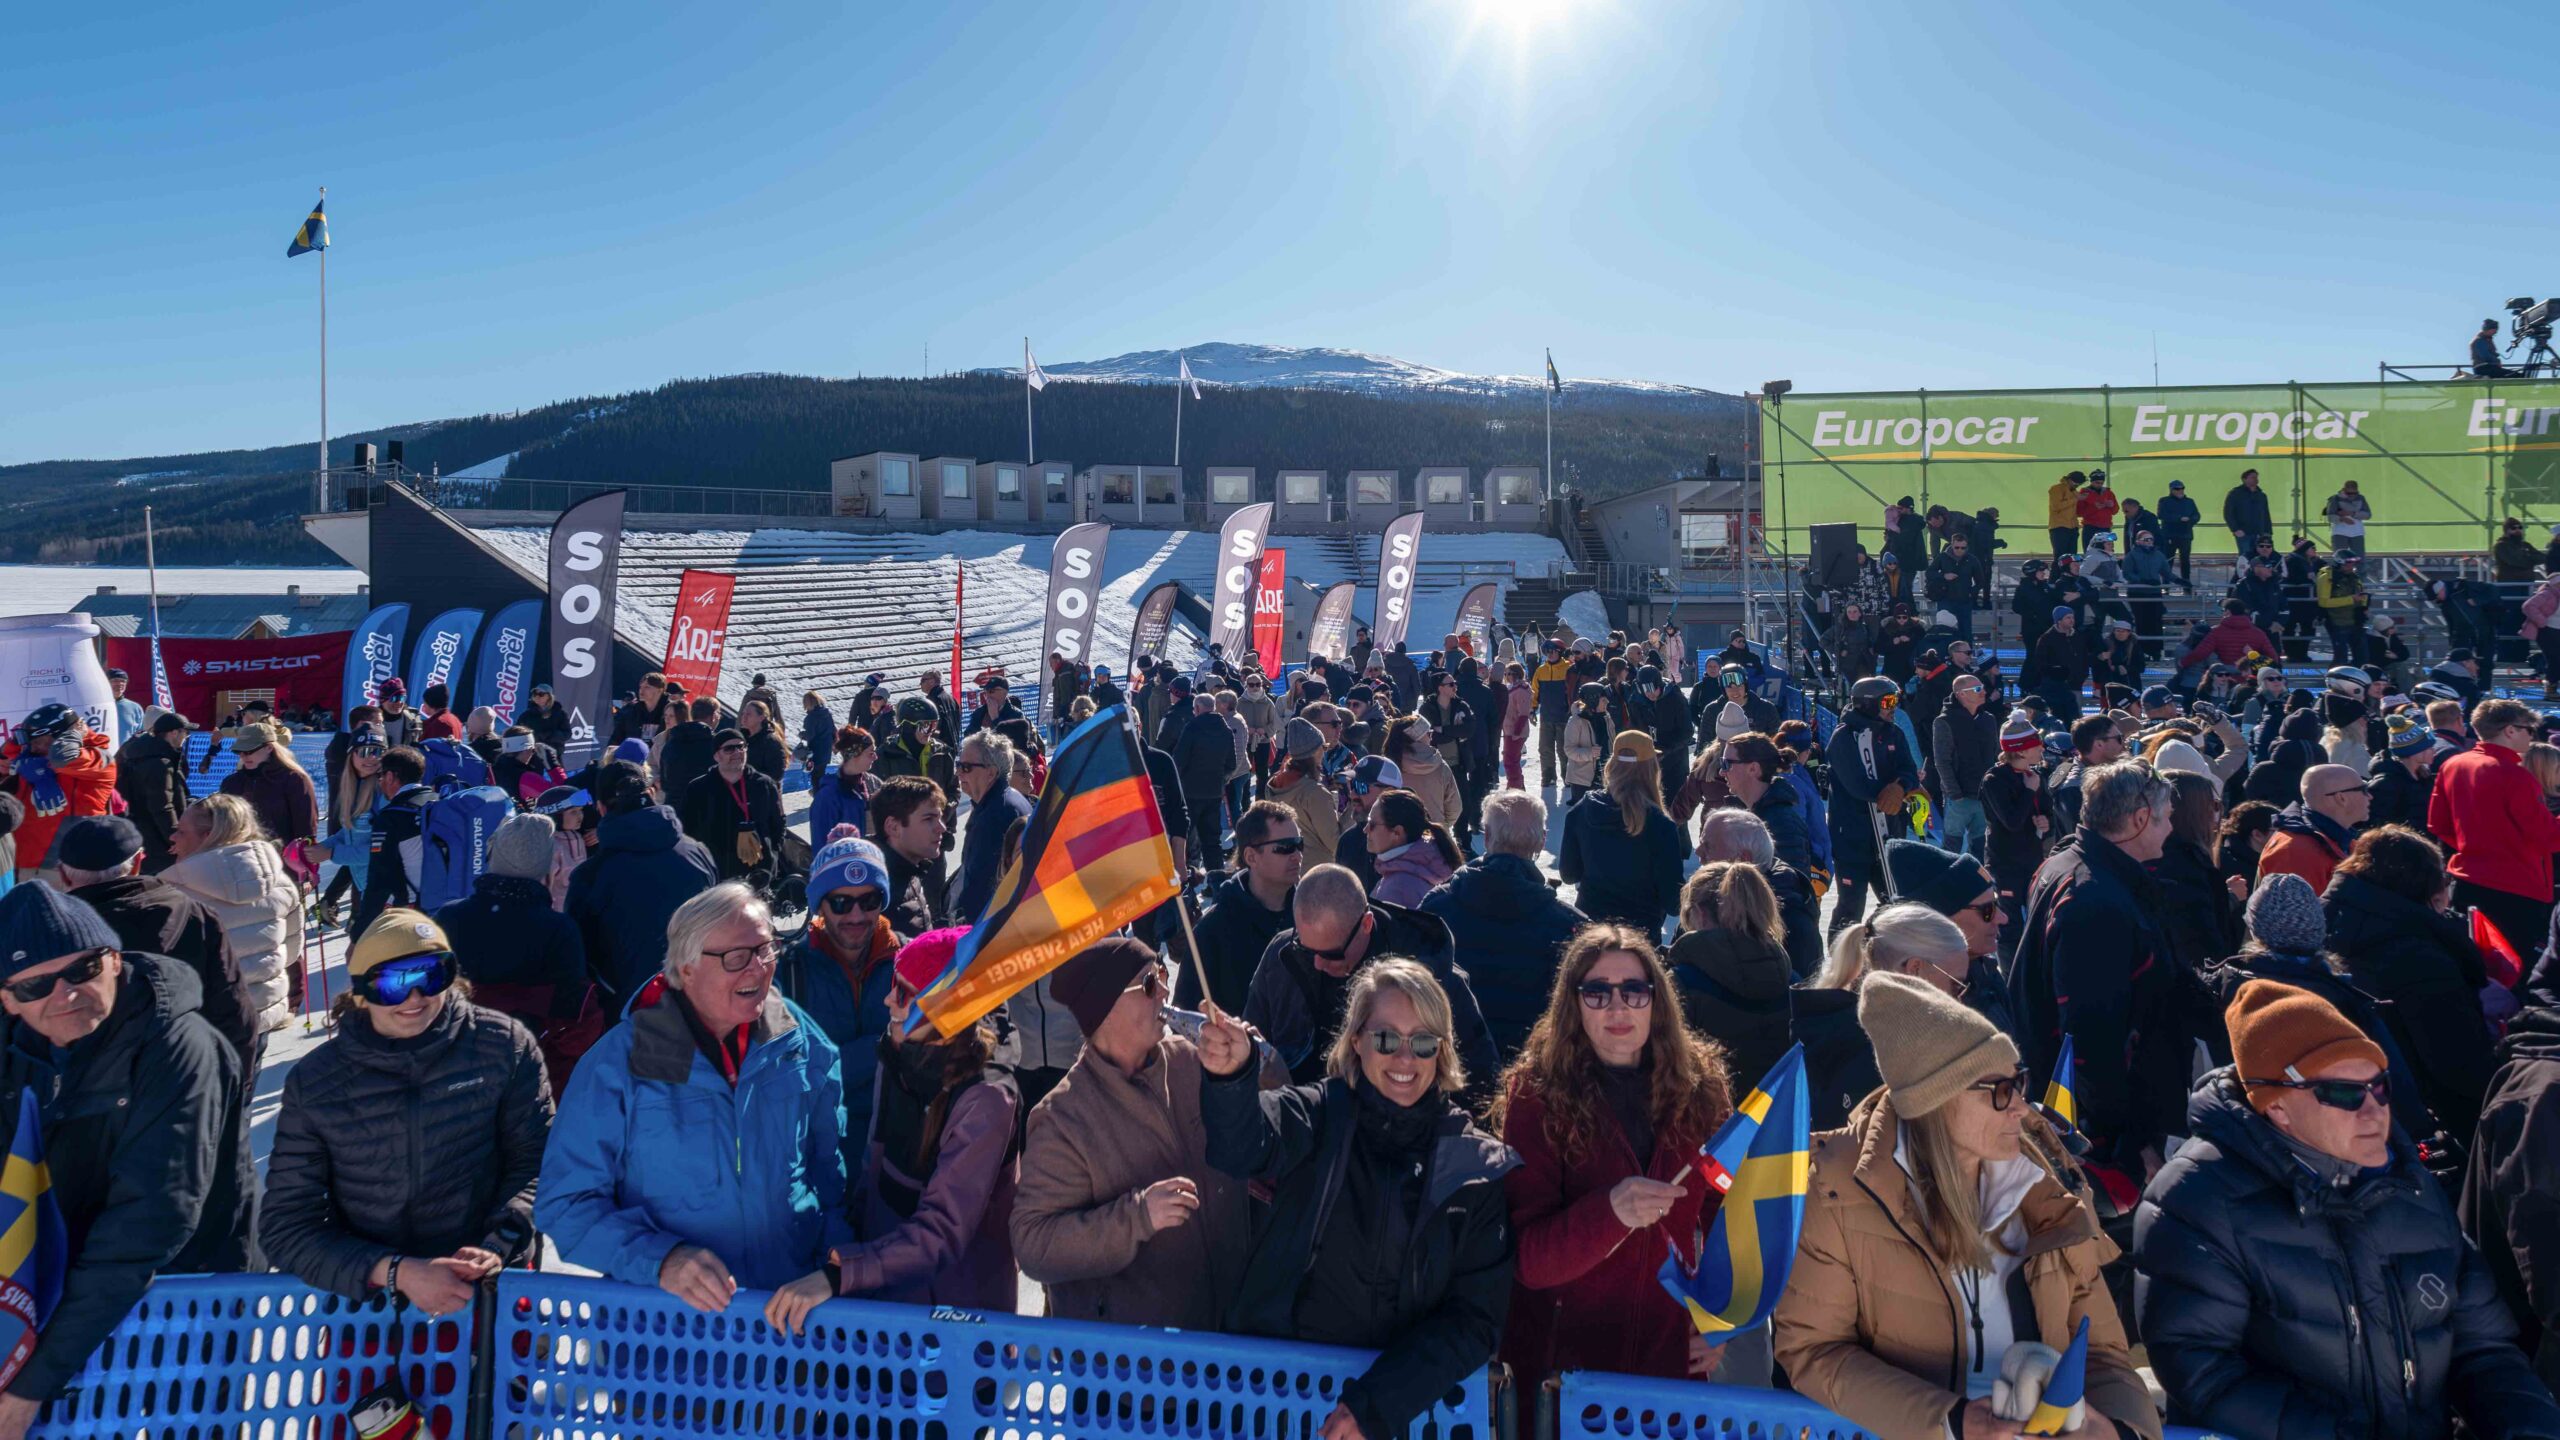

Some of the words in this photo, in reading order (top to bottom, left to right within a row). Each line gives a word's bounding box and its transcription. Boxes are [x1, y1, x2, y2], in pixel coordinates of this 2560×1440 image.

[1812, 411, 2039, 459] Europcar
[2130, 405, 2369, 455] Europcar
[2467, 399, 2560, 435] Eur
[560, 532, 603, 678] SOS
[1053, 548, 1092, 659] SOS
[1222, 529, 1256, 630] SOS
[1385, 533, 1412, 621] SOS
[671, 616, 723, 662] ÅRE
[492, 628, 527, 726] Actimel
[473, 817, 483, 875] SALOMON
